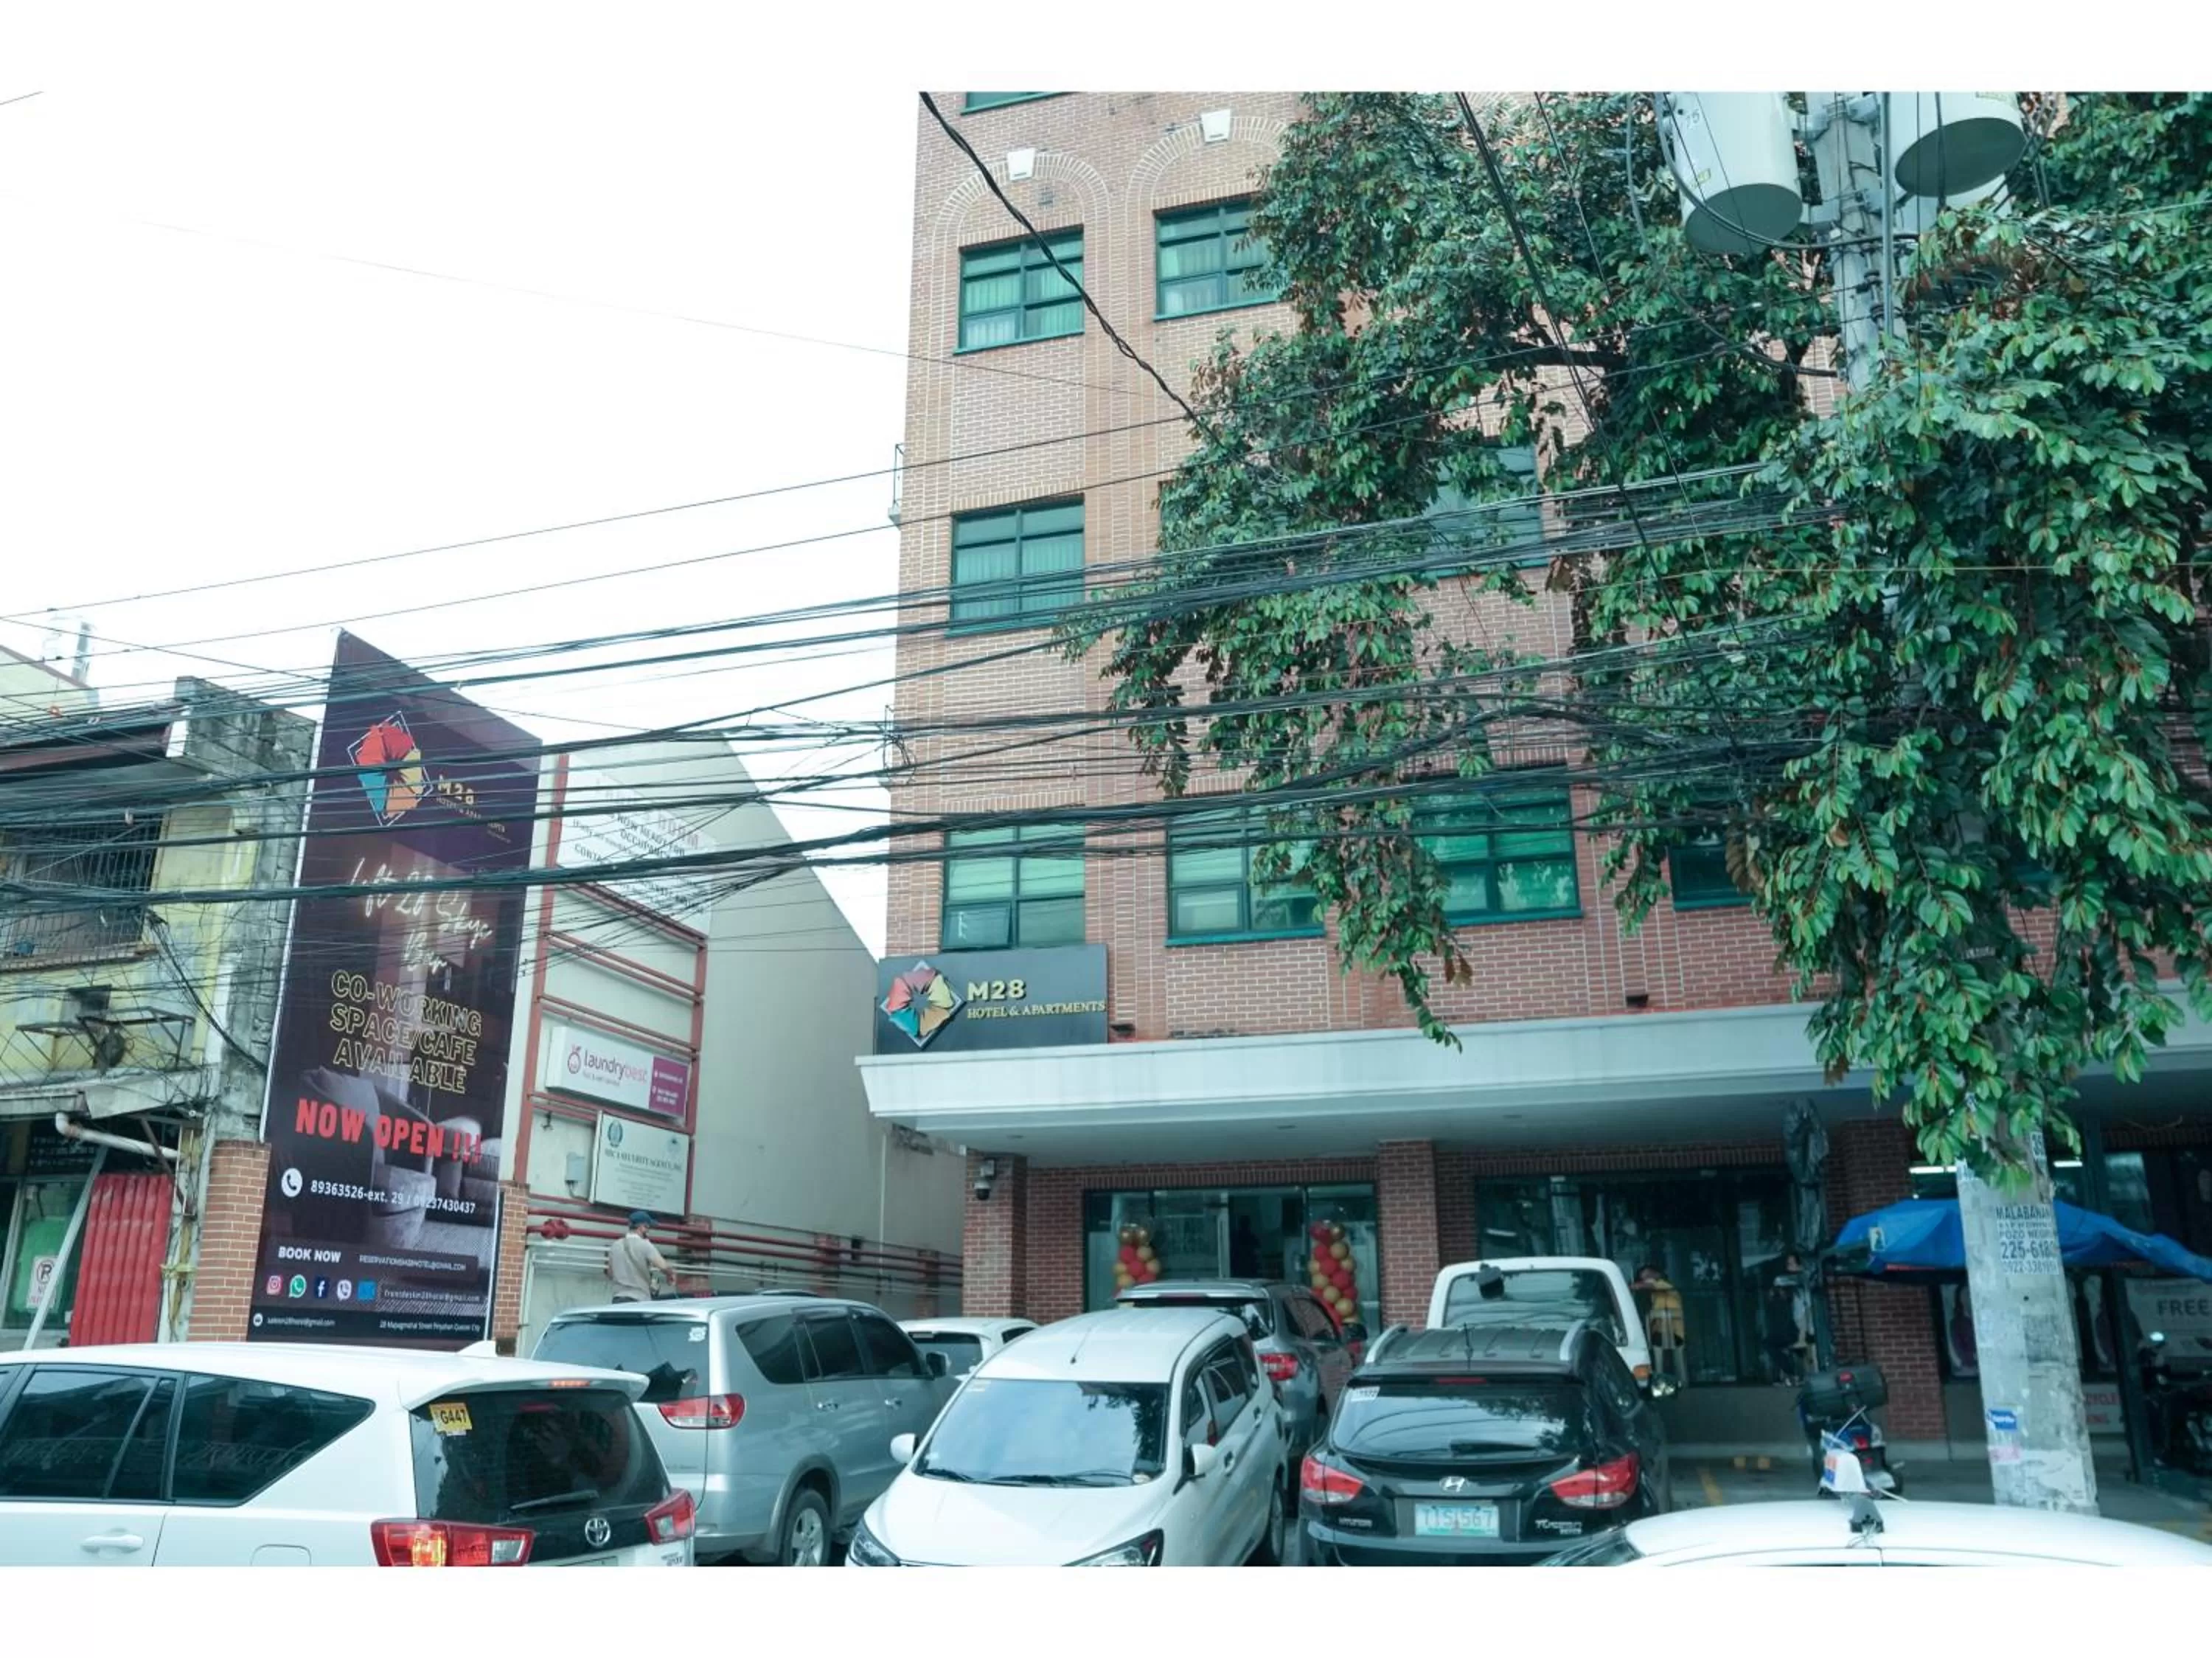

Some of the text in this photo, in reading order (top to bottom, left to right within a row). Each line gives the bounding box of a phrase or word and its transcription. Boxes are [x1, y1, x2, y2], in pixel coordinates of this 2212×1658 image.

[332, 968, 481, 1038] CO-WORKING
[967, 979, 1026, 1001] M28
[967, 1000, 1105, 1019] HOTEL & APARTMENTS
[330, 1003, 478, 1066] SPACE/CAFE
[333, 1038, 467, 1095] AVAILABLE
[295, 1097, 366, 1143] NOW
[374, 1114, 445, 1158] OPEN
[278, 1246, 342, 1263] BOOK NOW
